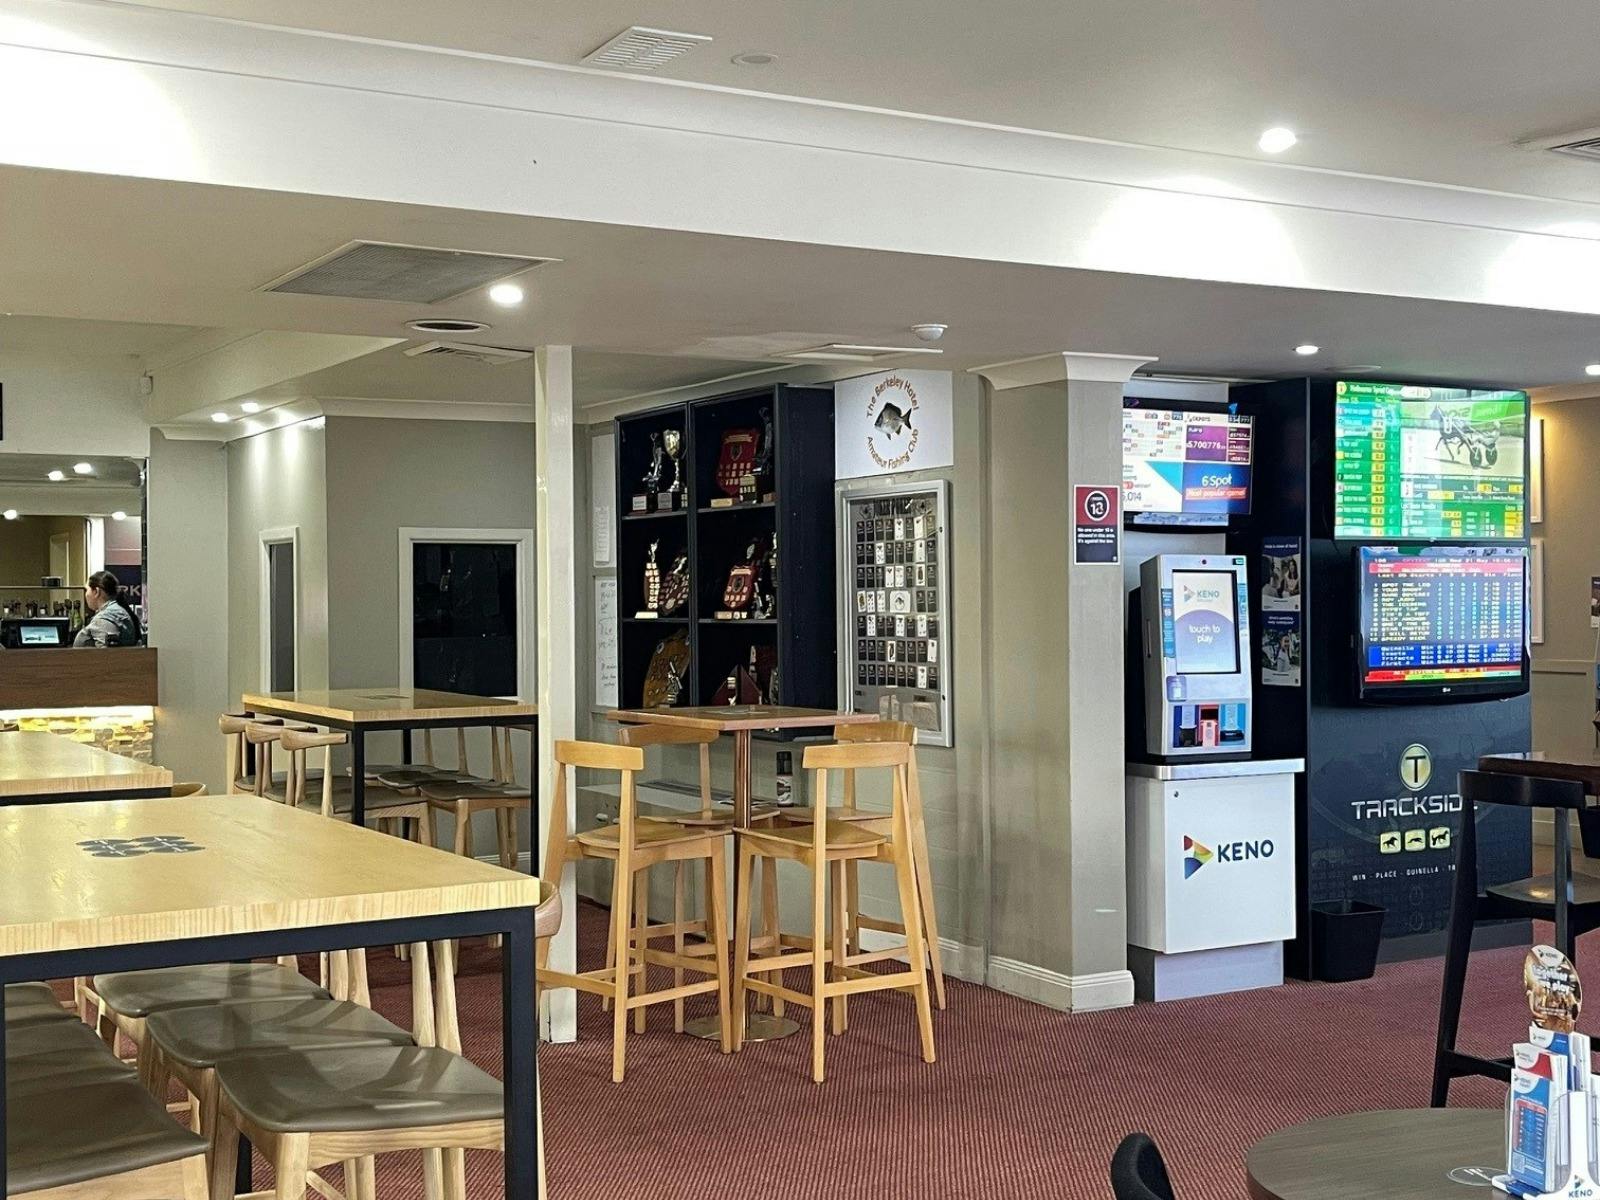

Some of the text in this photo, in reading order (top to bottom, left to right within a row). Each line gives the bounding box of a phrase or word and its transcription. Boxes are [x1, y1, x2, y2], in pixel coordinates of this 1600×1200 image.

[866, 375, 920, 418] The Berkeley Hotel
[867, 428, 919, 470] Amateur Fishing Club
[1201, 473, 1233, 489] 6 Spot
[1197, 590, 1220, 599] KENO
[1189, 623, 1221, 634] touch to
[1197, 635, 1213, 646] play
[1351, 793, 1478, 820] TRACKSID
[1218, 839, 1275, 863] KENO
[1352, 873, 1366, 881] WIN
[1375, 869, 1398, 879] PLACE
[1406, 865, 1439, 876] QUINELLA
[1568, 1188, 1594, 1198] KENO
